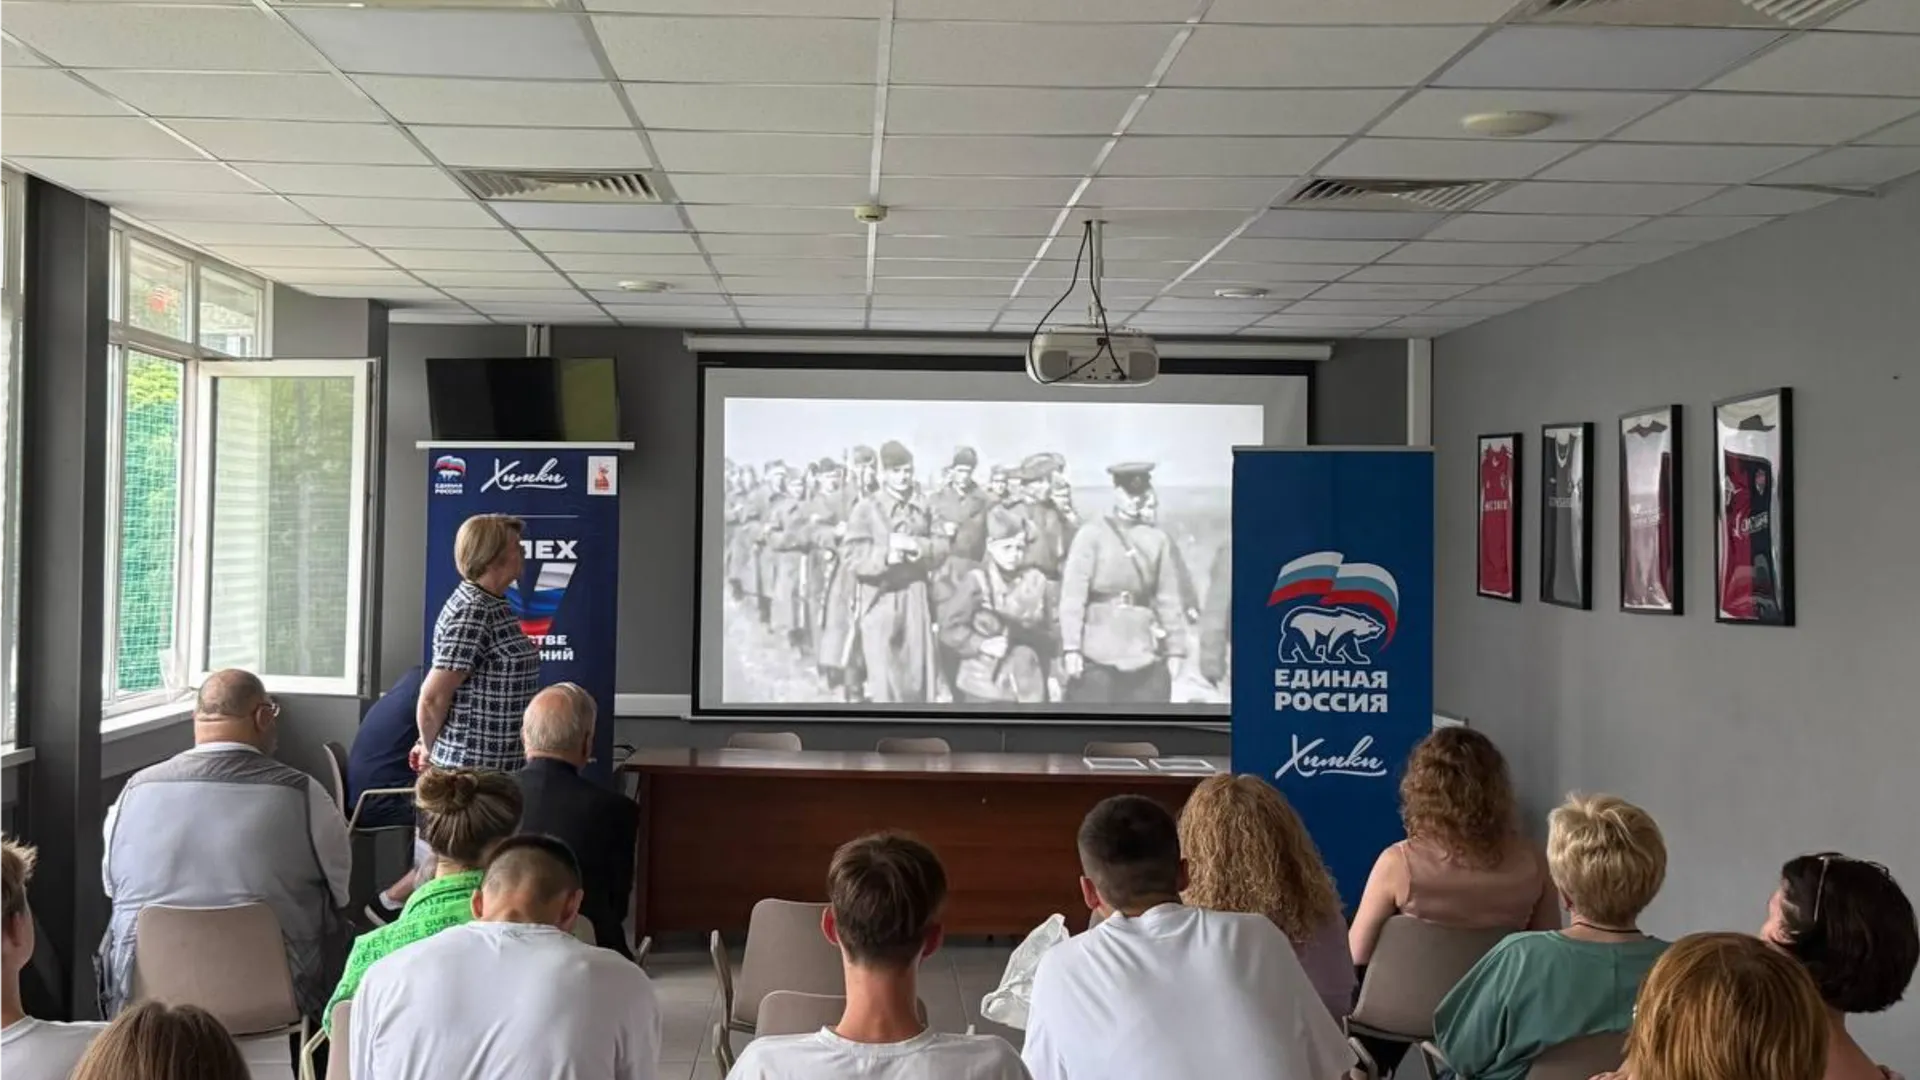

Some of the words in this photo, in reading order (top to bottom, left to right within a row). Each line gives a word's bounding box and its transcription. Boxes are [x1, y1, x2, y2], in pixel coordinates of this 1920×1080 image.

[480, 457, 568, 493] Химки
[539, 647, 575, 661] НИЙ
[1274, 668, 1388, 689] ЕДИНАЯ
[1274, 692, 1388, 713] РОССИЯ
[1274, 733, 1388, 780] Химки
